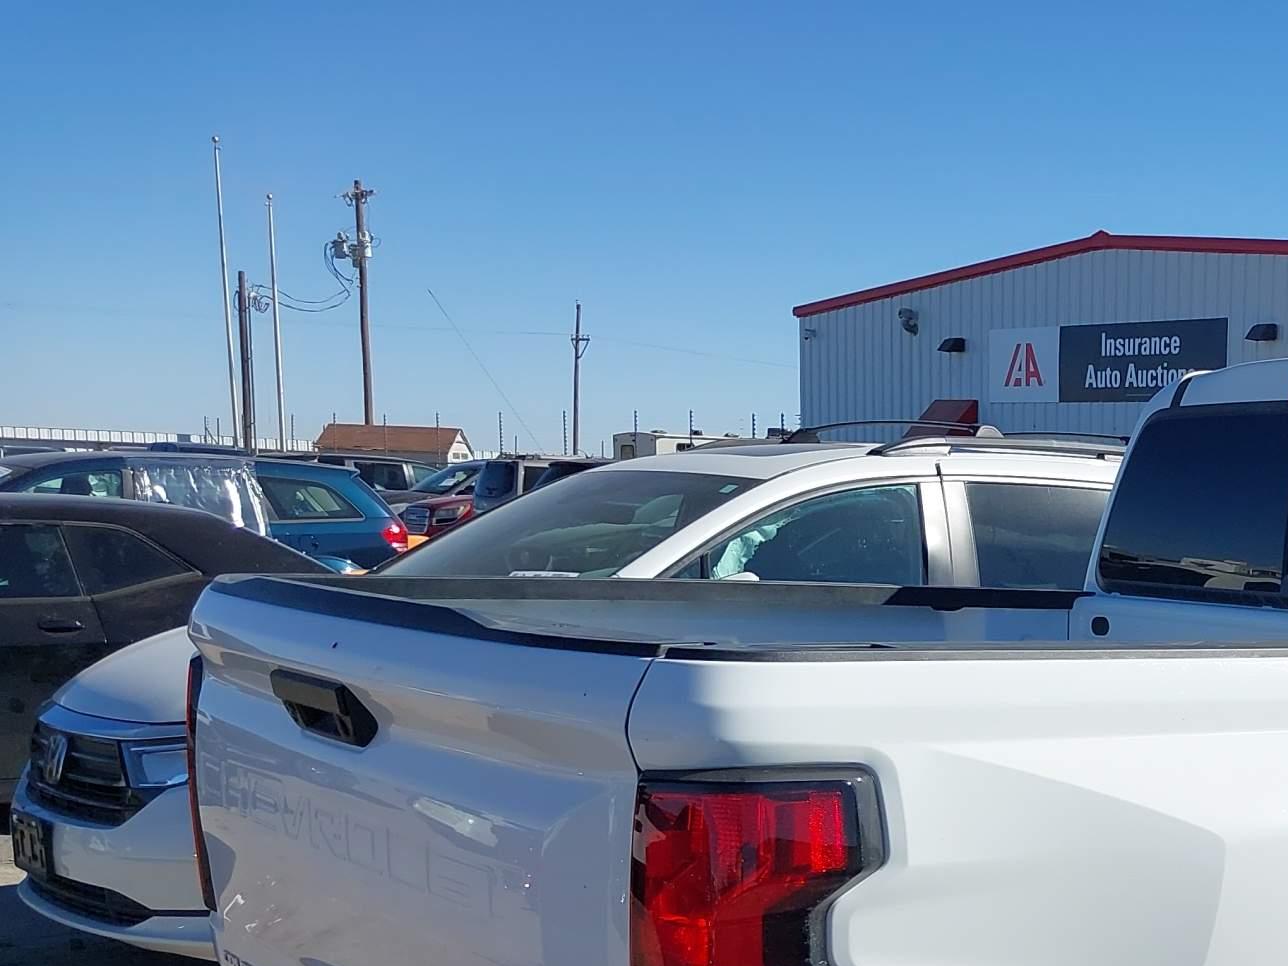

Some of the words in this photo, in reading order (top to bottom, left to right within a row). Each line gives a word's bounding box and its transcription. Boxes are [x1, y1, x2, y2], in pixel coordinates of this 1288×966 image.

[1101, 332, 1180, 357] Insurance
[1085, 364, 1121, 389] Auto
[1125, 362, 1196, 388] Auction
